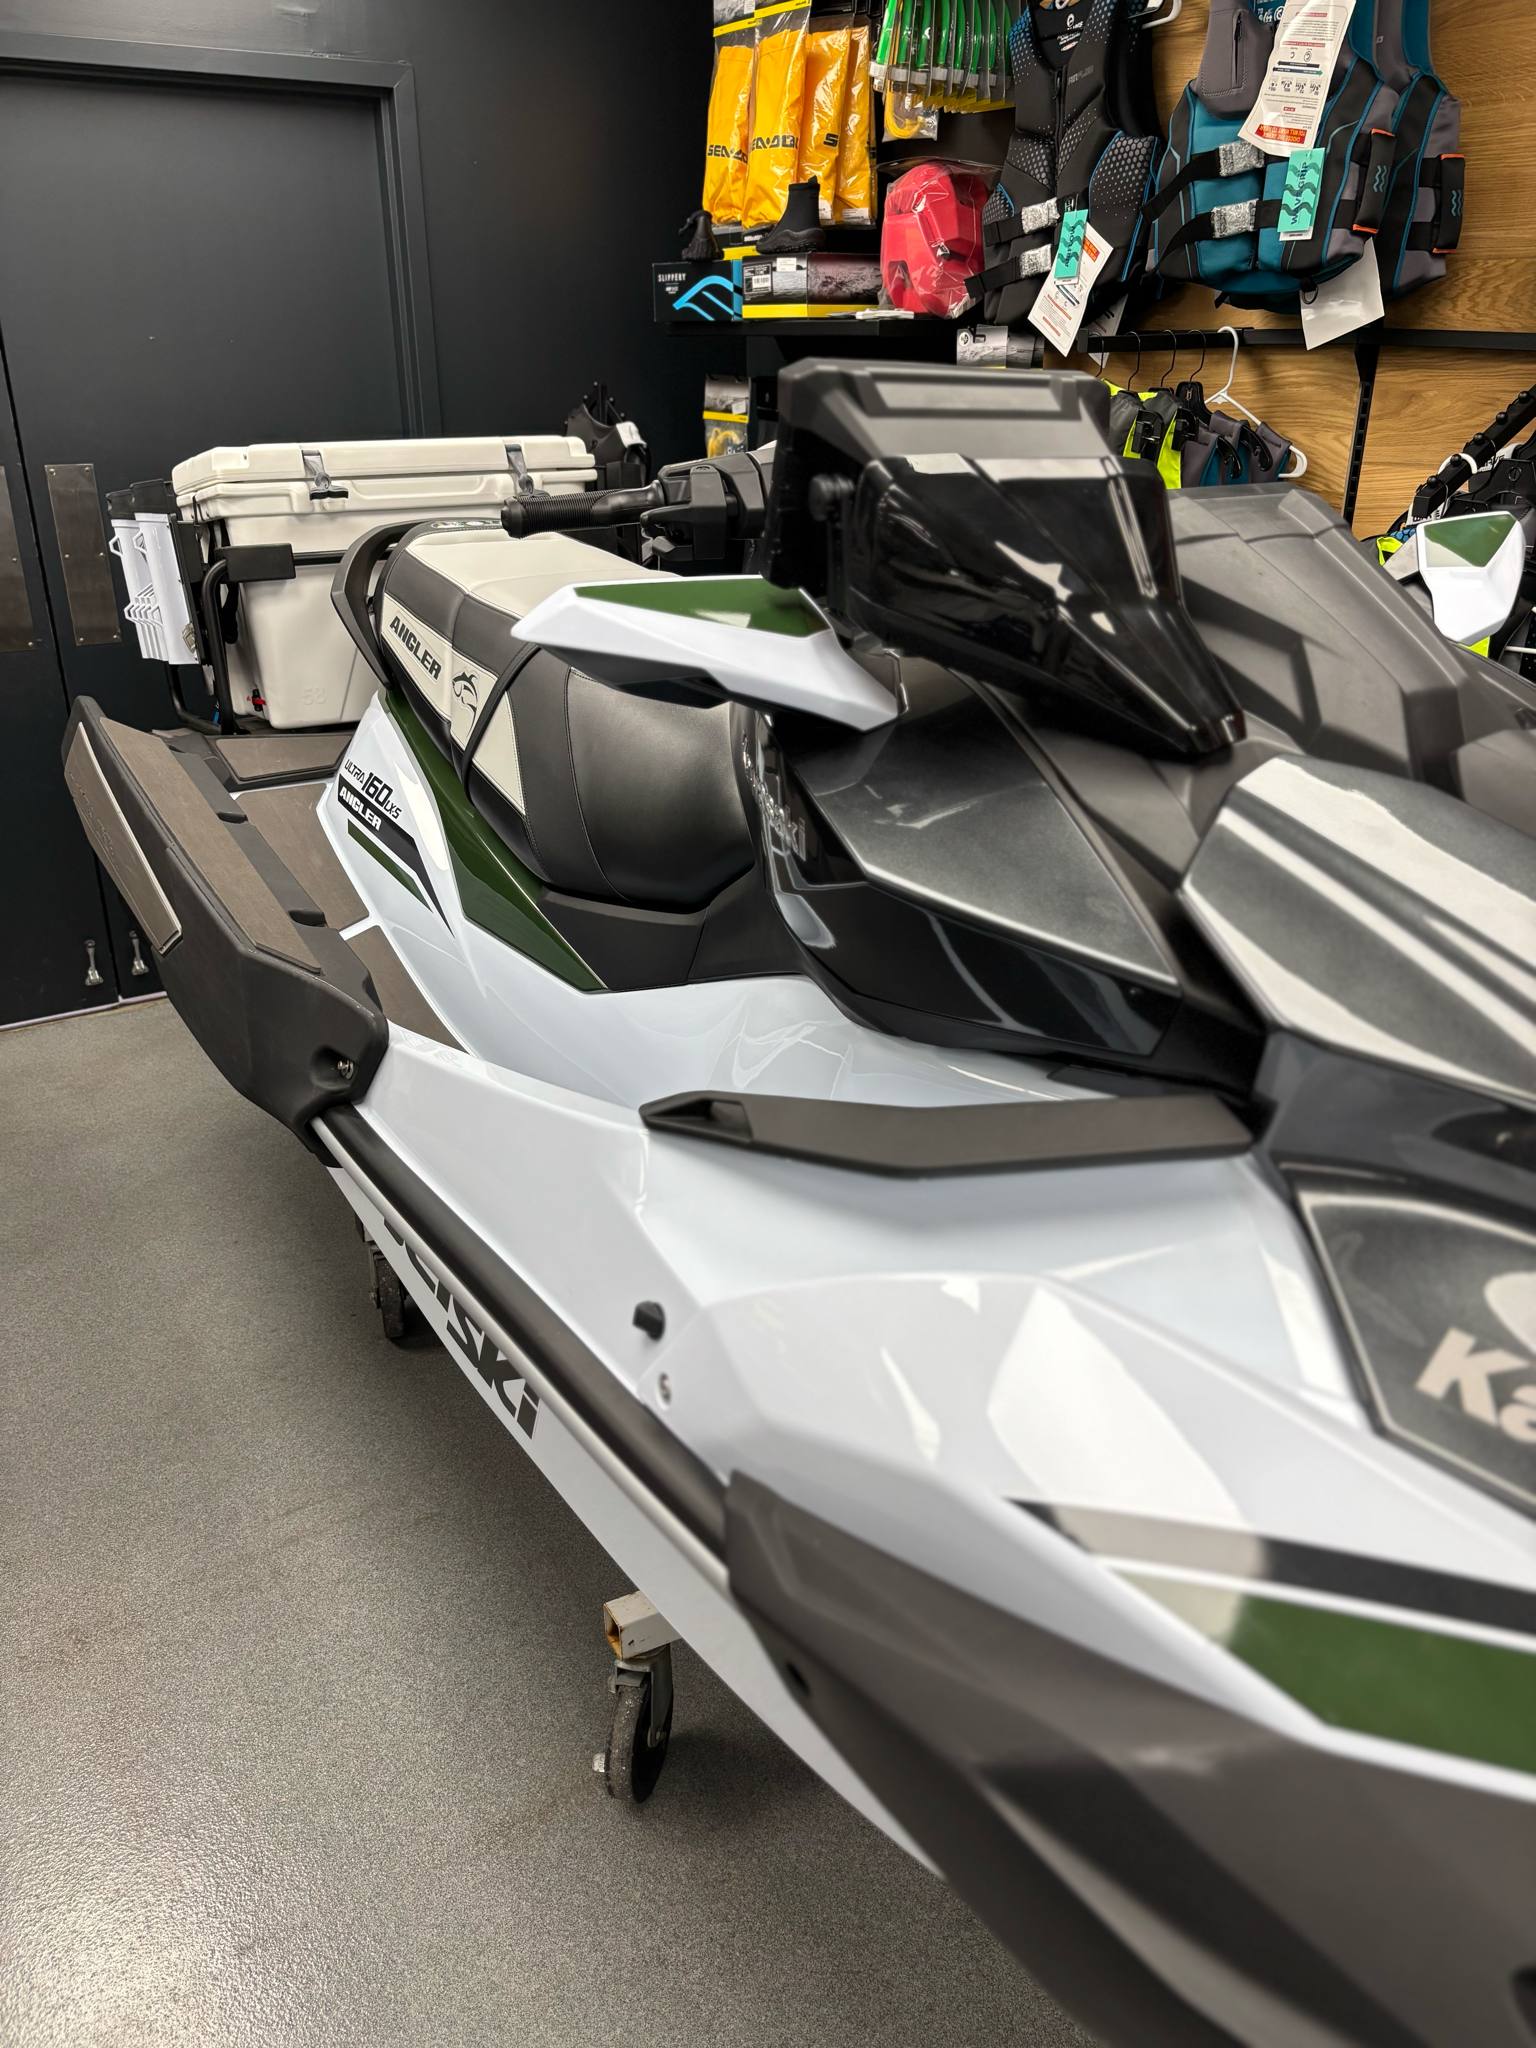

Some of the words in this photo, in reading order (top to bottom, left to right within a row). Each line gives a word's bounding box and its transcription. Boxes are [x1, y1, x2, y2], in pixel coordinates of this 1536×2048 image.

[1298, 162, 1309, 188] GRIP
[657, 273, 687, 283] SLIPPERY
[389, 615, 442, 681] ANGLER
[344, 759, 365, 784] ULTRA
[339, 785, 382, 831] ANGLER
